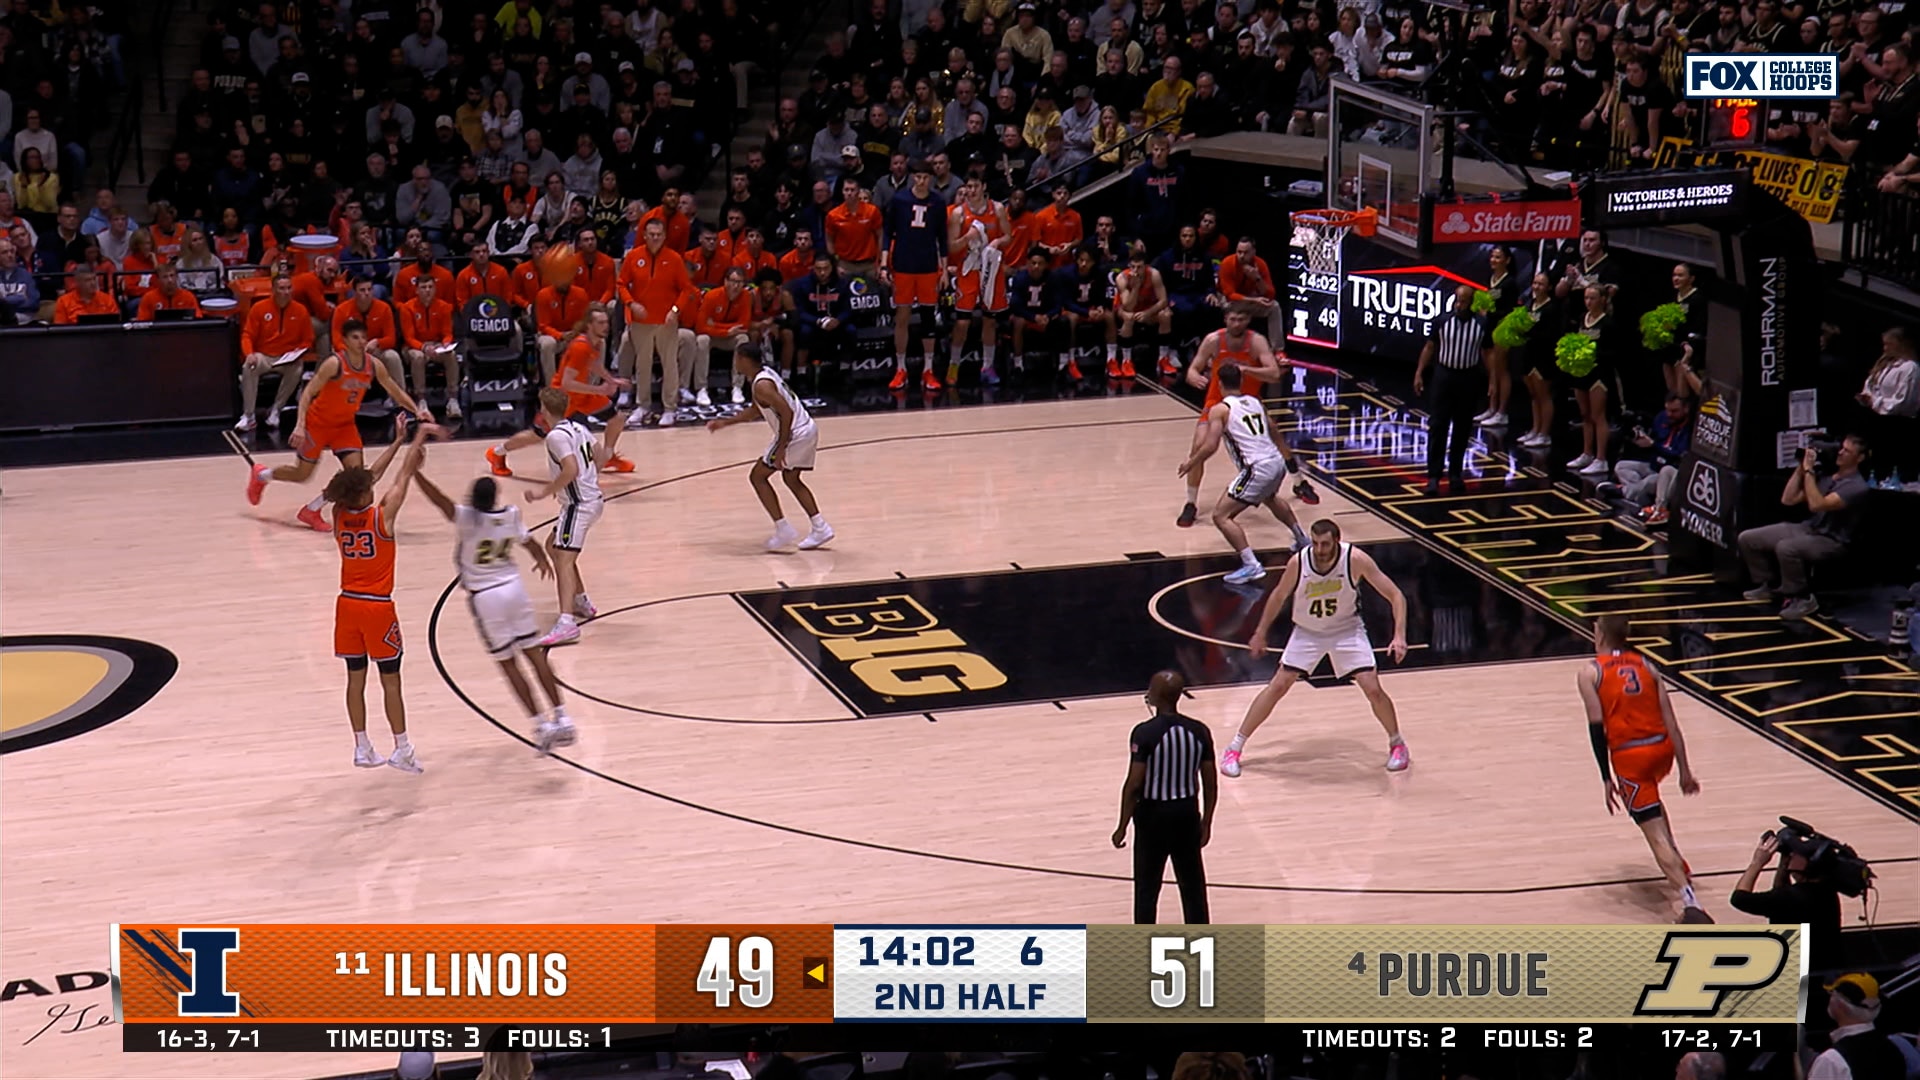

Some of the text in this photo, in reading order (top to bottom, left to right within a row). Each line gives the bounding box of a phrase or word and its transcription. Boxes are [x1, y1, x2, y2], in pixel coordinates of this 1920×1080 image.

[1731, 108, 1751, 138] 6
[1760, 158, 1800, 185] LIVES
[1614, 188, 1675, 204] VICTORIES
[1687, 184, 1733, 199] HEROES
[1299, 271, 1338, 292] 14:02
[849, 294, 881, 311] EMCO
[470, 317, 510, 333] GEMCO
[1318, 307, 1339, 328] 49
[1364, 311, 1414, 333] REAL
[1758, 257, 1780, 386] ROHRMAN
[1242, 413, 1264, 436] 17
[340, 530, 377, 559] 23
[475, 537, 513, 565] 24
[1309, 597, 1338, 619] 45
[1617, 666, 1643, 695] 3
